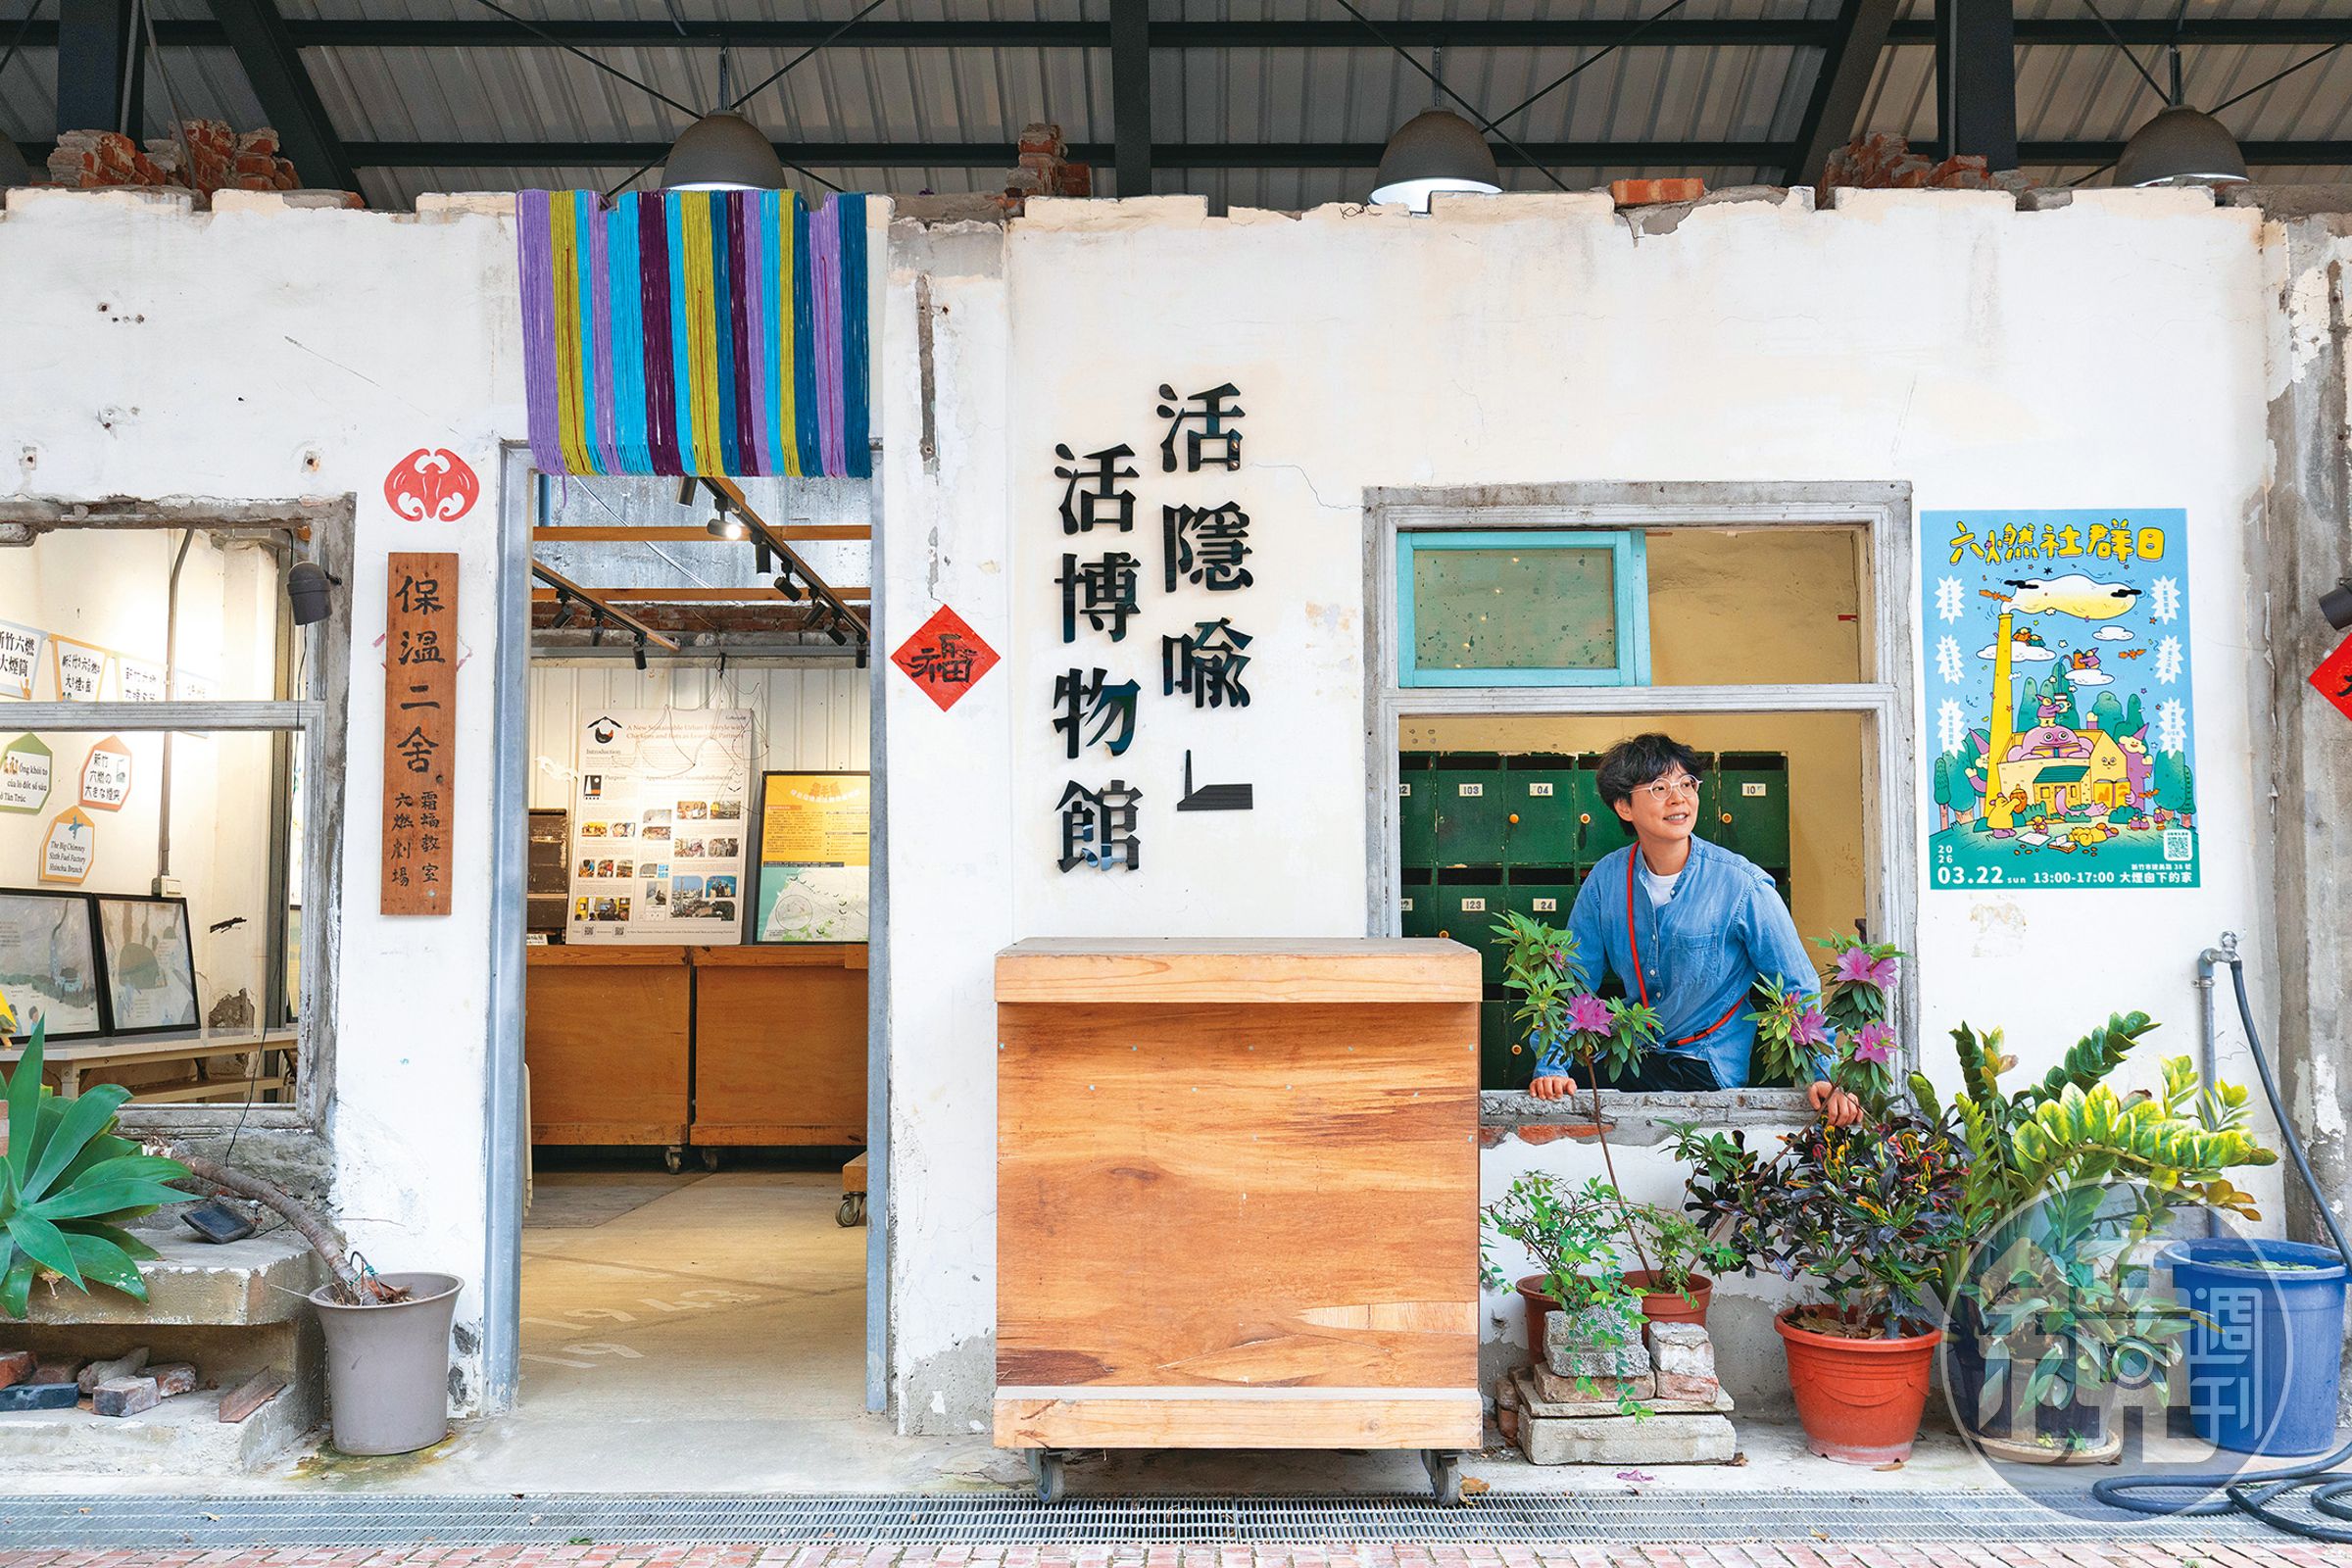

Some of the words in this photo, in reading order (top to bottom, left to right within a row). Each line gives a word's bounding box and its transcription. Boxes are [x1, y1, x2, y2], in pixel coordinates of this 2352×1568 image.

[1156, 382, 1253, 709] 活隱喻
[1950, 518, 2165, 565] 六燃社群日
[898, 633, 978, 683] 福
[1054, 443, 1144, 872] 活博物館
[395, 575, 445, 773] 保溫二舍
[1463, 786, 1479, 795] 103
[1937, 845, 1953, 854] 20
[1937, 855, 1953, 863] 26
[1937, 866, 2003, 884] 03.22
[2034, 871, 2115, 883] 13:00-17:00
[1466, 901, 1481, 909] 123
